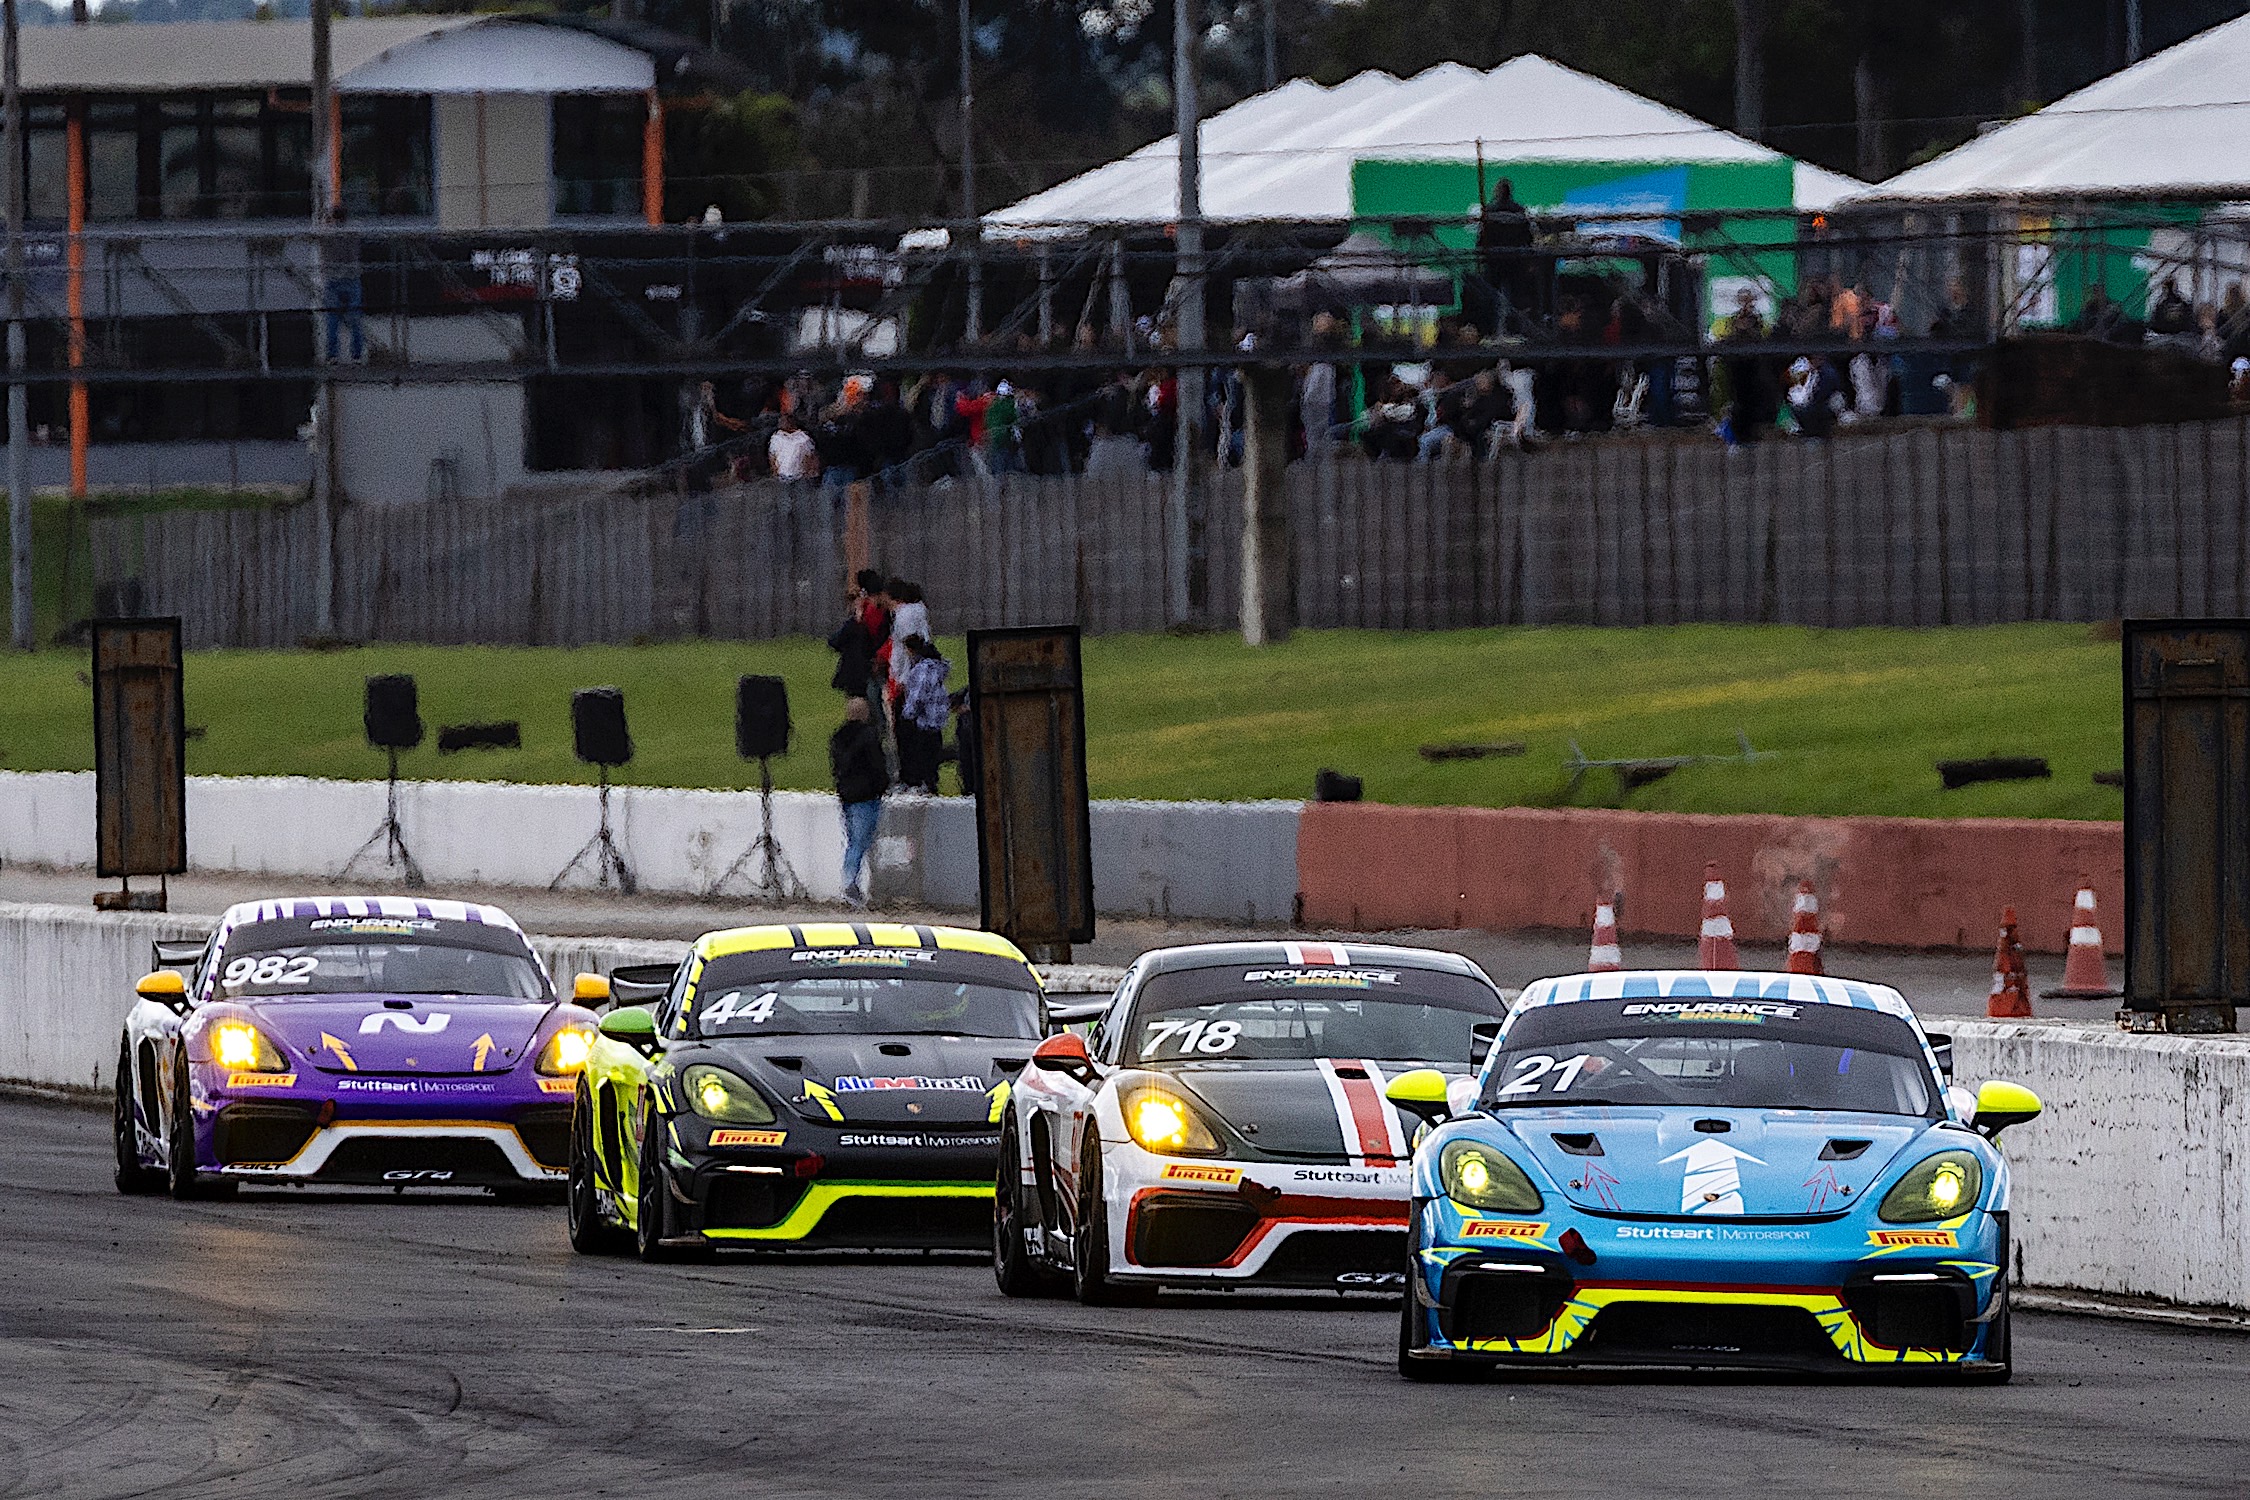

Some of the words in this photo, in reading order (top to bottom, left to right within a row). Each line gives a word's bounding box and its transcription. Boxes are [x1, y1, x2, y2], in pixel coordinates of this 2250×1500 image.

[310, 918, 438, 930] ENDURANCE
[791, 949, 935, 961] ENDURANCE
[222, 956, 319, 988] 982
[1245, 970, 1397, 982] ENDURANCE
[698, 991, 779, 1025] 44
[1622, 1002, 1798, 1017] ENDURANCE
[1678, 1011, 1760, 1021] BRASIL
[1141, 1020, 1242, 1057] 718
[1497, 1054, 1591, 1096] 21
[337, 1079, 418, 1092] Stuttgart
[716, 1131, 779, 1143] PIRELLI
[840, 1134, 924, 1146] Stuttgart
[383, 1170, 454, 1181] GT4
[1167, 1165, 1236, 1182] PIRELLI
[1293, 1170, 1381, 1185] Stuttgart
[1466, 1222, 1541, 1237] PIRELLI
[1616, 1226, 1714, 1240] Stuttgart
[1877, 1230, 1951, 1246] PIRELLI
